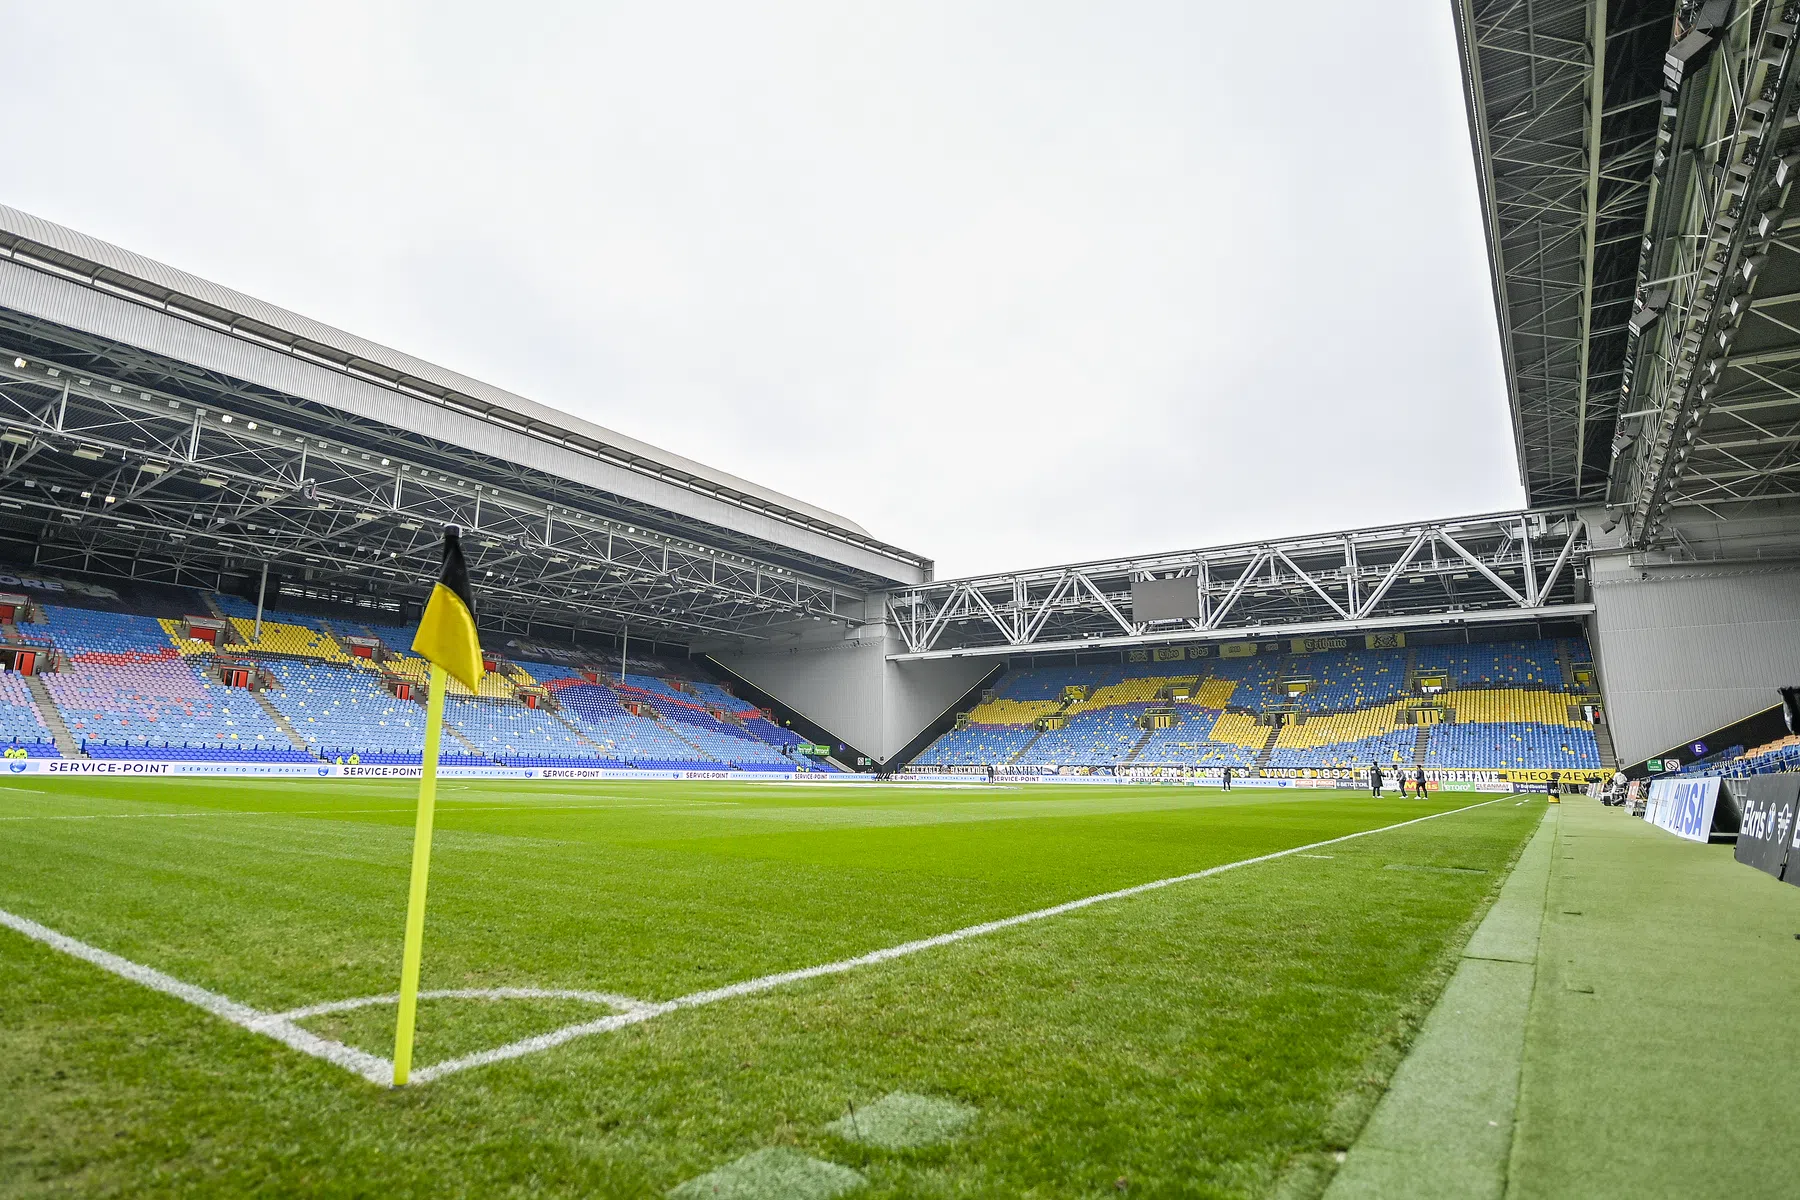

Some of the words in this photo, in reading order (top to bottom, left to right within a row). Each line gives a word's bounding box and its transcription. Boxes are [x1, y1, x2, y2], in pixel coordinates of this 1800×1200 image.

[1304, 637, 1348, 652] Tribune
[1695, 744, 1702, 753] E
[49, 762, 169, 773] SERVICE-POINT
[343, 767, 423, 776] SERVICE-POINT
[1002, 766, 1043, 776] ARNHEM
[543, 770, 599, 778] SERVICE-POINT
[1263, 768, 1297, 779] VIVO
[1317, 769, 1350, 779] 1892
[1424, 770, 1499, 782] MISBEHAVE
[1508, 770, 1548, 781] THEO
[1741, 800, 1766, 840] Ekris
